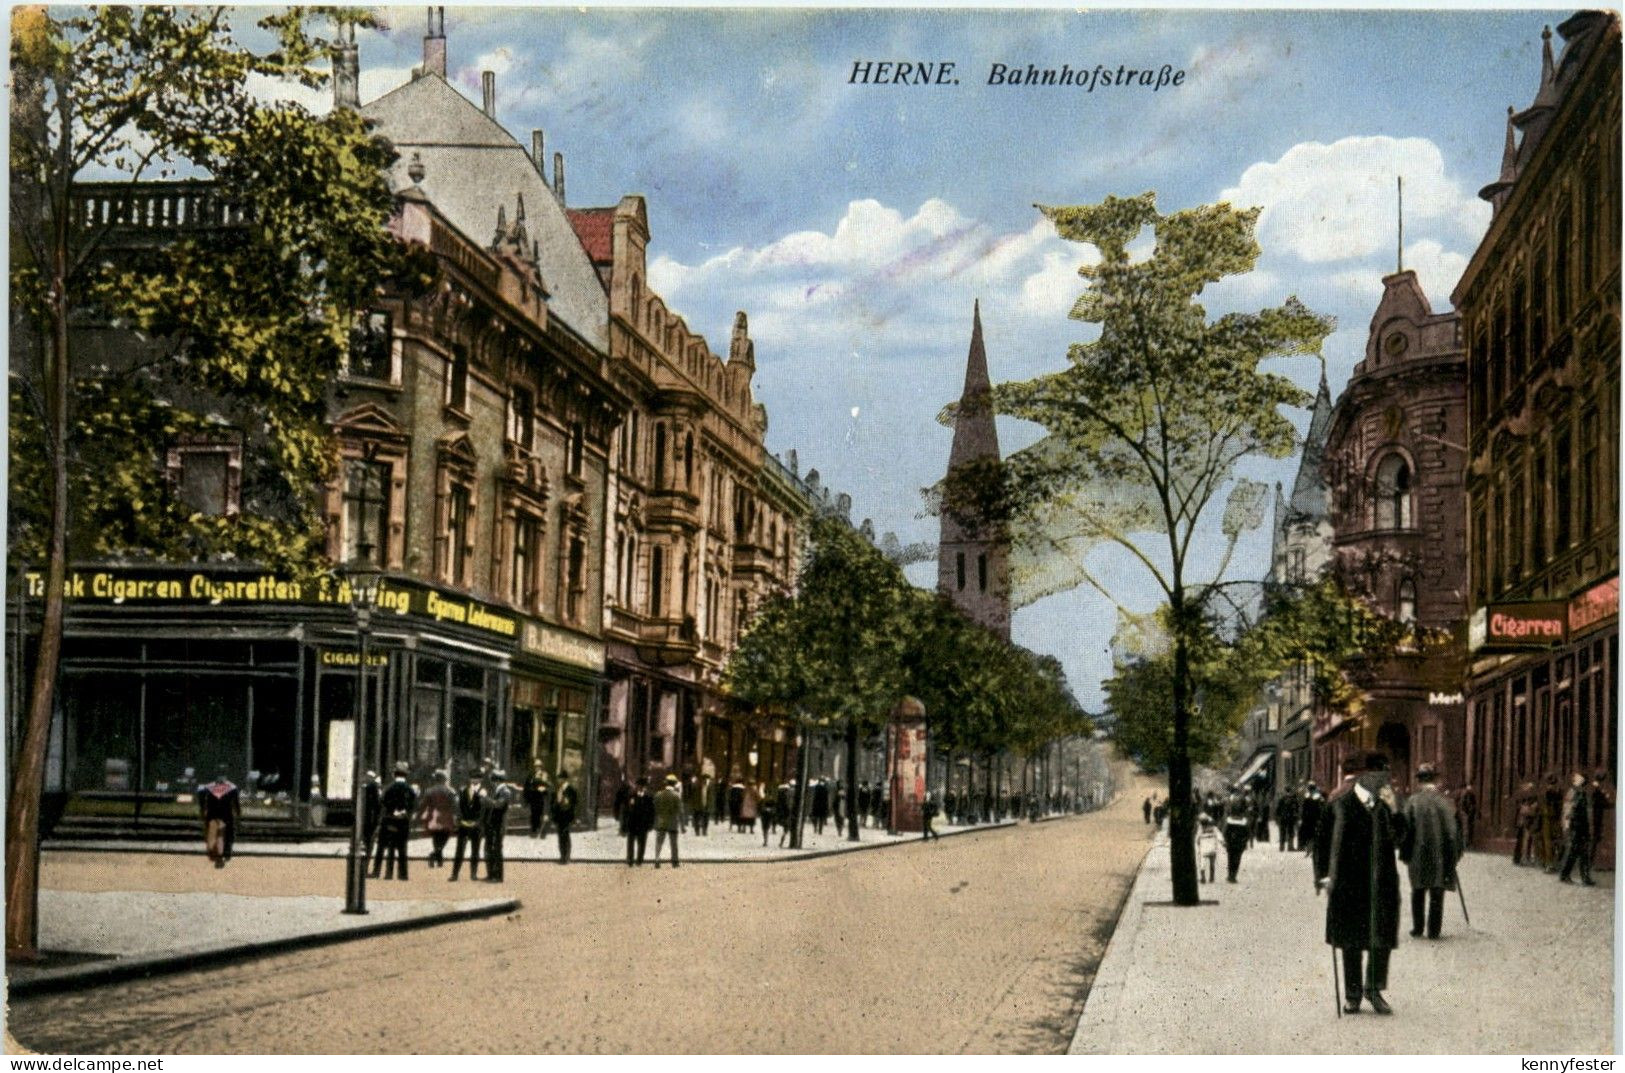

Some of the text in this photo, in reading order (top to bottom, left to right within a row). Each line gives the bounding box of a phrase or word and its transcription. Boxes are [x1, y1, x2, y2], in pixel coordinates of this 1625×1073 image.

[25, 572, 85, 597] Taak
[190, 574, 301, 605] Cigaretten
[1491, 613, 1562, 638] Cigarren
